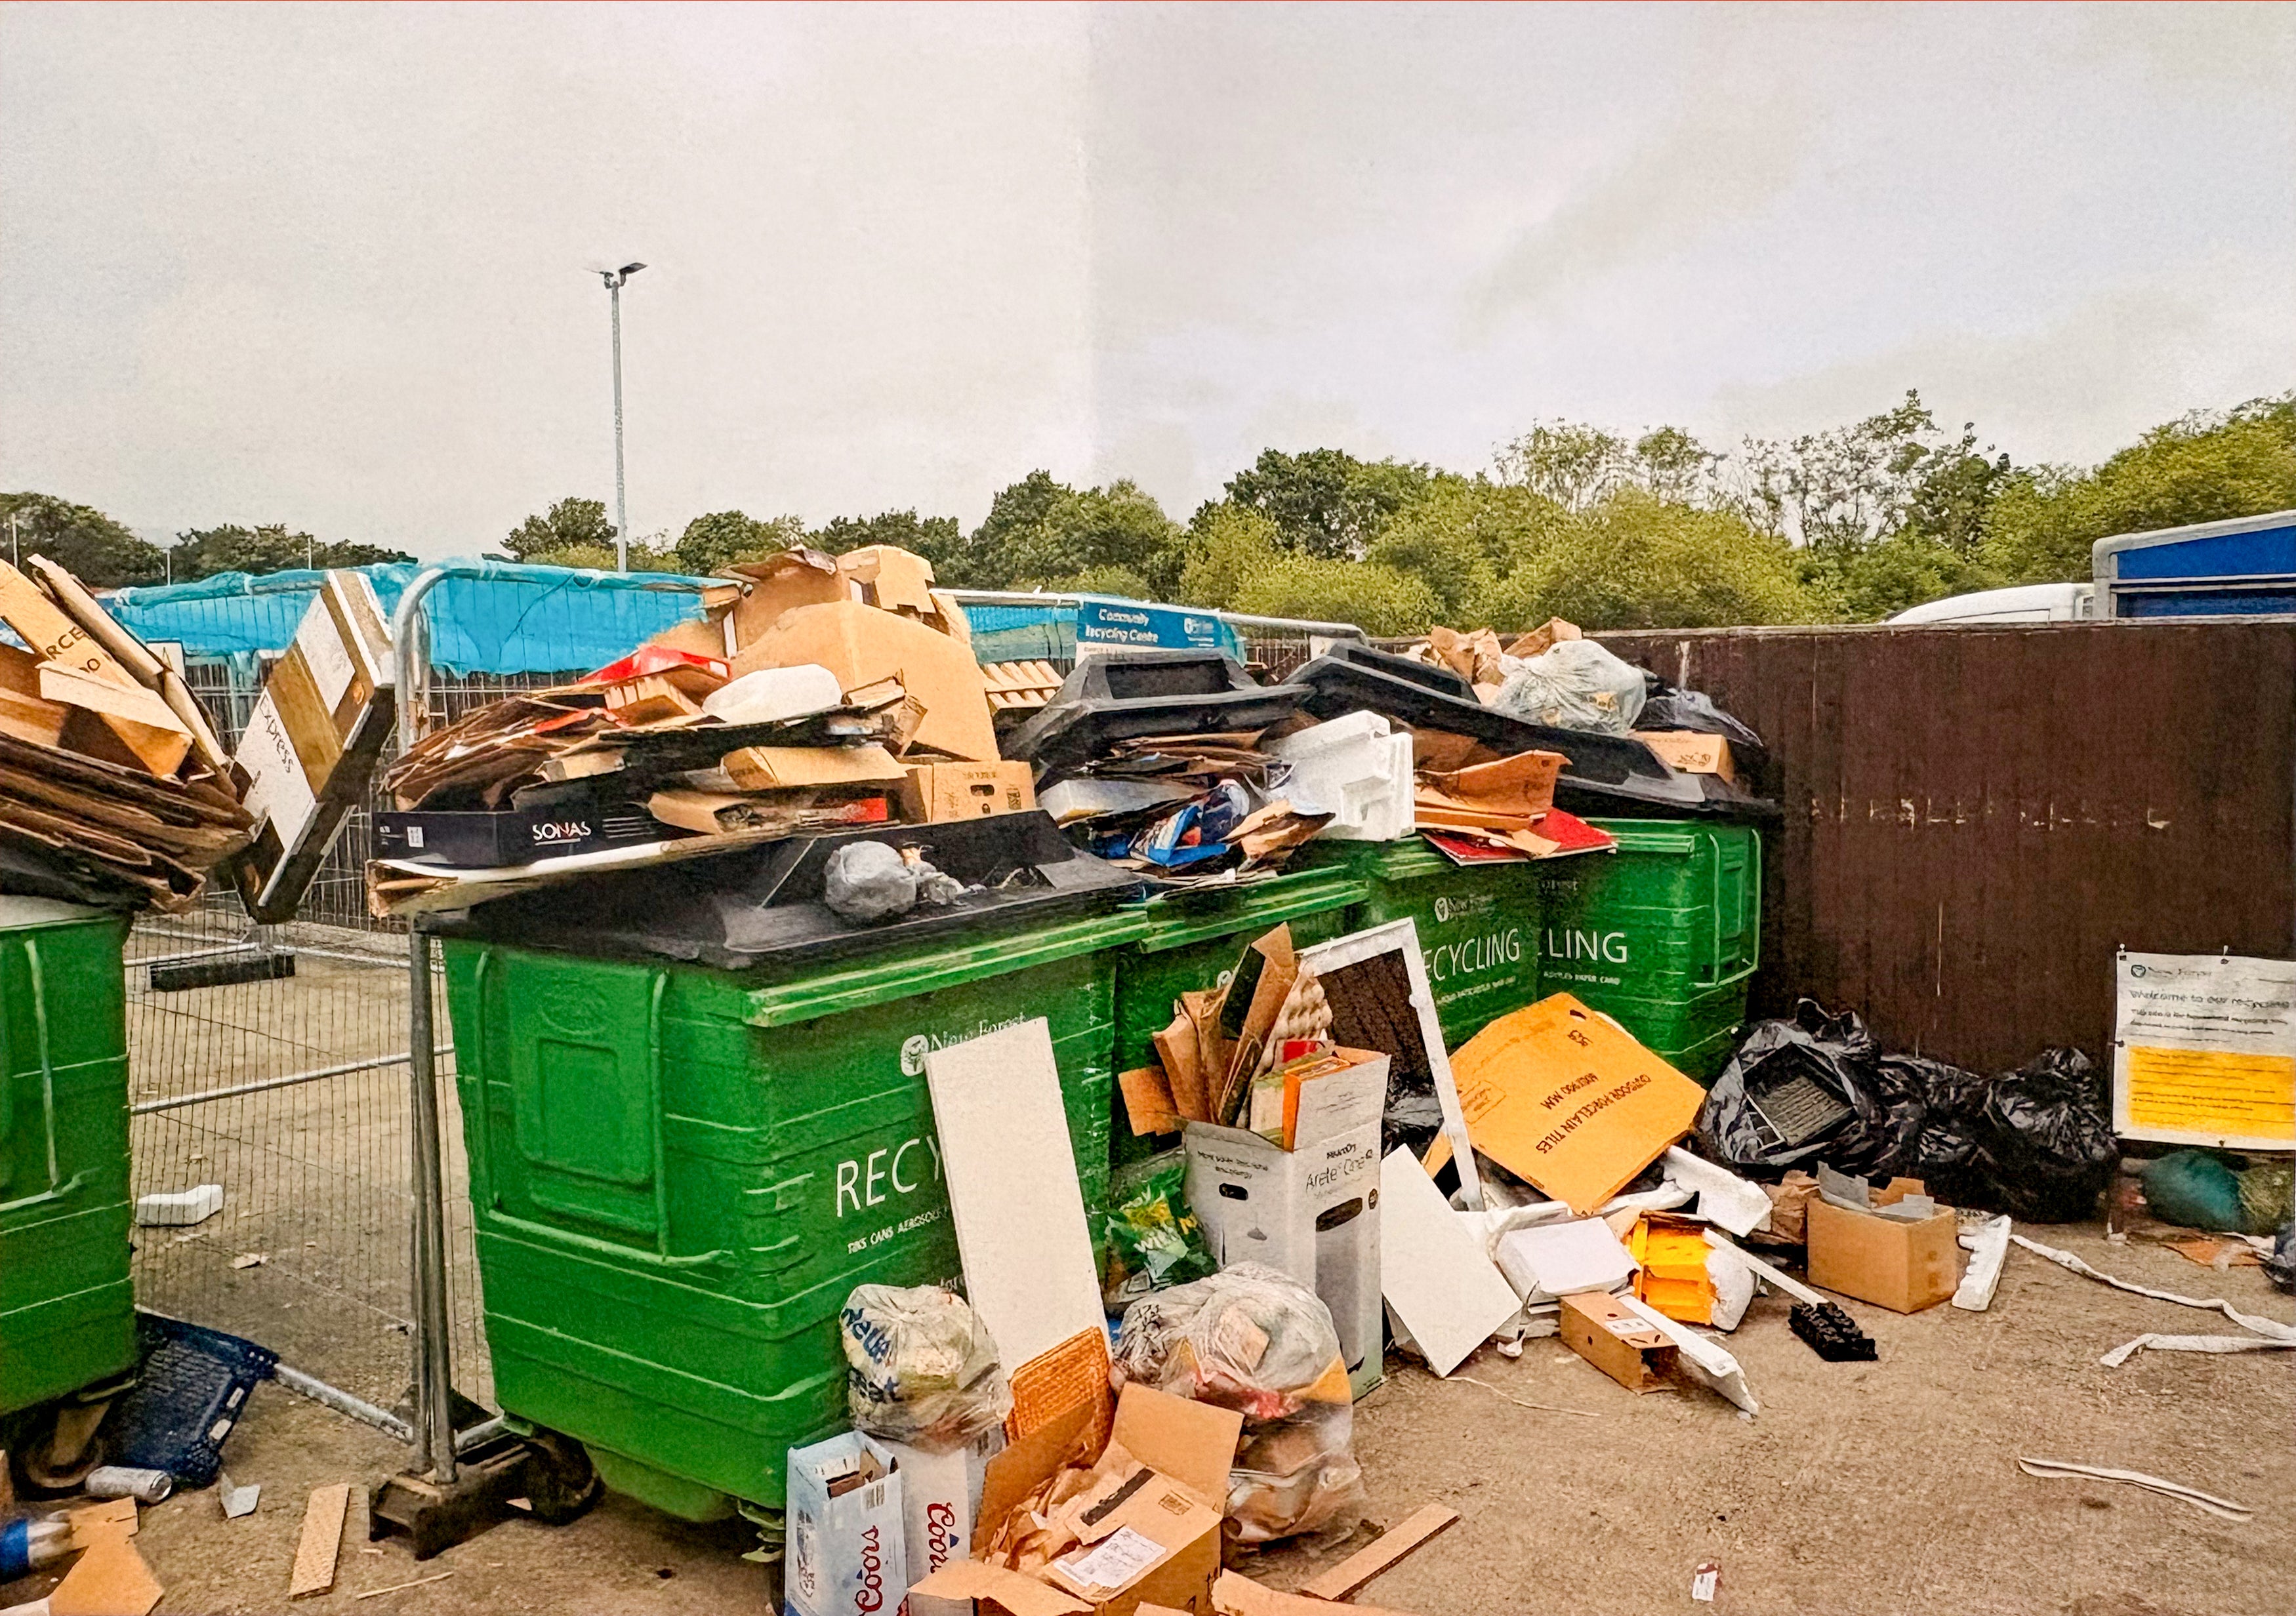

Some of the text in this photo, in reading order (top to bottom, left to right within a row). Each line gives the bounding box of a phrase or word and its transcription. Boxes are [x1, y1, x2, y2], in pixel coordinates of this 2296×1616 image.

[532, 821, 592, 841] SONAS
[1542, 927, 1628, 963] LING
[854, 1525, 883, 1612] Coors
